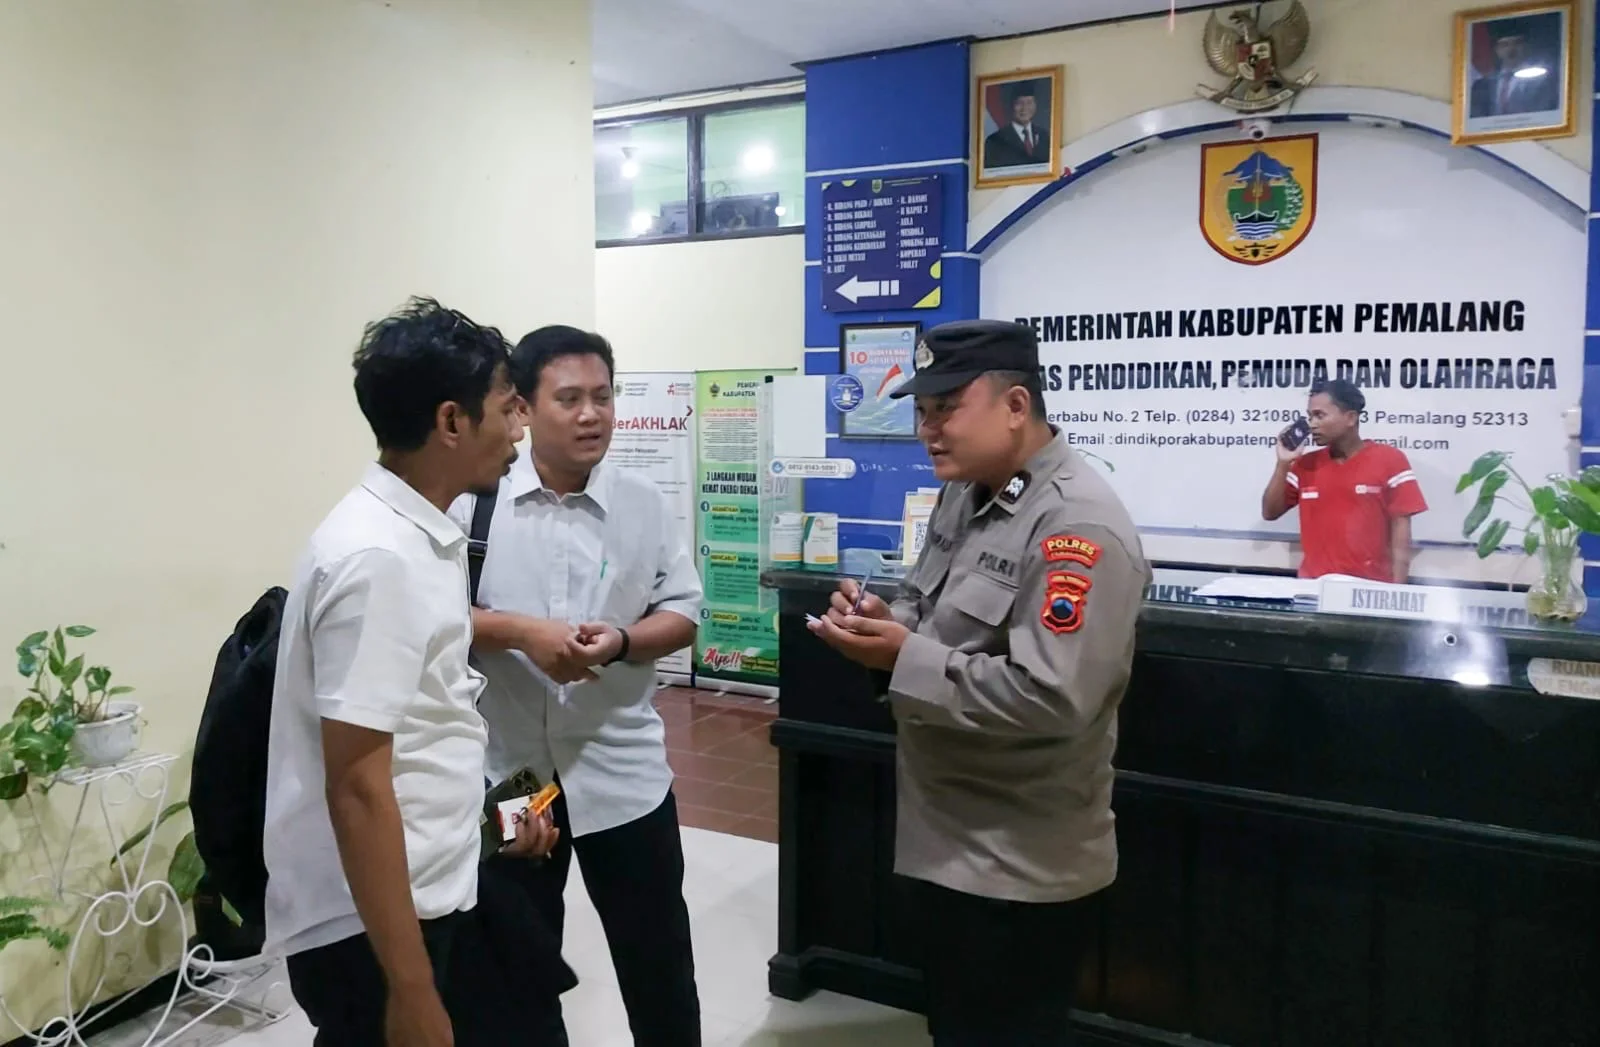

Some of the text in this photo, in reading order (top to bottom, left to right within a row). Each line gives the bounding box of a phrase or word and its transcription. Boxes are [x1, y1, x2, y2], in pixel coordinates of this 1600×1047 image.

[1179, 304, 1344, 338] KABUPATEN
[1354, 300, 1525, 333] PEMALANG
[850, 351, 868, 365] 10
[1068, 361, 1217, 391] PENDIDIKAN,
[1221, 358, 1328, 390] PEMUDA
[1336, 358, 1391, 389] DAN
[1400, 357, 1557, 391] OLAHRAGA
[1047, 410, 1098, 423] erbabu
[1144, 409, 1181, 425] Telp.
[1186, 409, 1235, 425] (0284)
[1359, 410, 1369, 424] 3
[1375, 411, 1466, 428] Pemalang
[1472, 412, 1528, 426] 52313
[1067, 432, 1105, 446] Email
[711, 472, 736, 482] LANGKAH
[720, 484, 739, 495] ENERGI
[740, 485, 758, 495] DENGA
[1047, 539, 1095, 555] POLRES
[977, 551, 1016, 577] POLRI
[1350, 588, 1428, 613] ISTIRAHAT
[1552, 660, 1600, 678] RUAN
